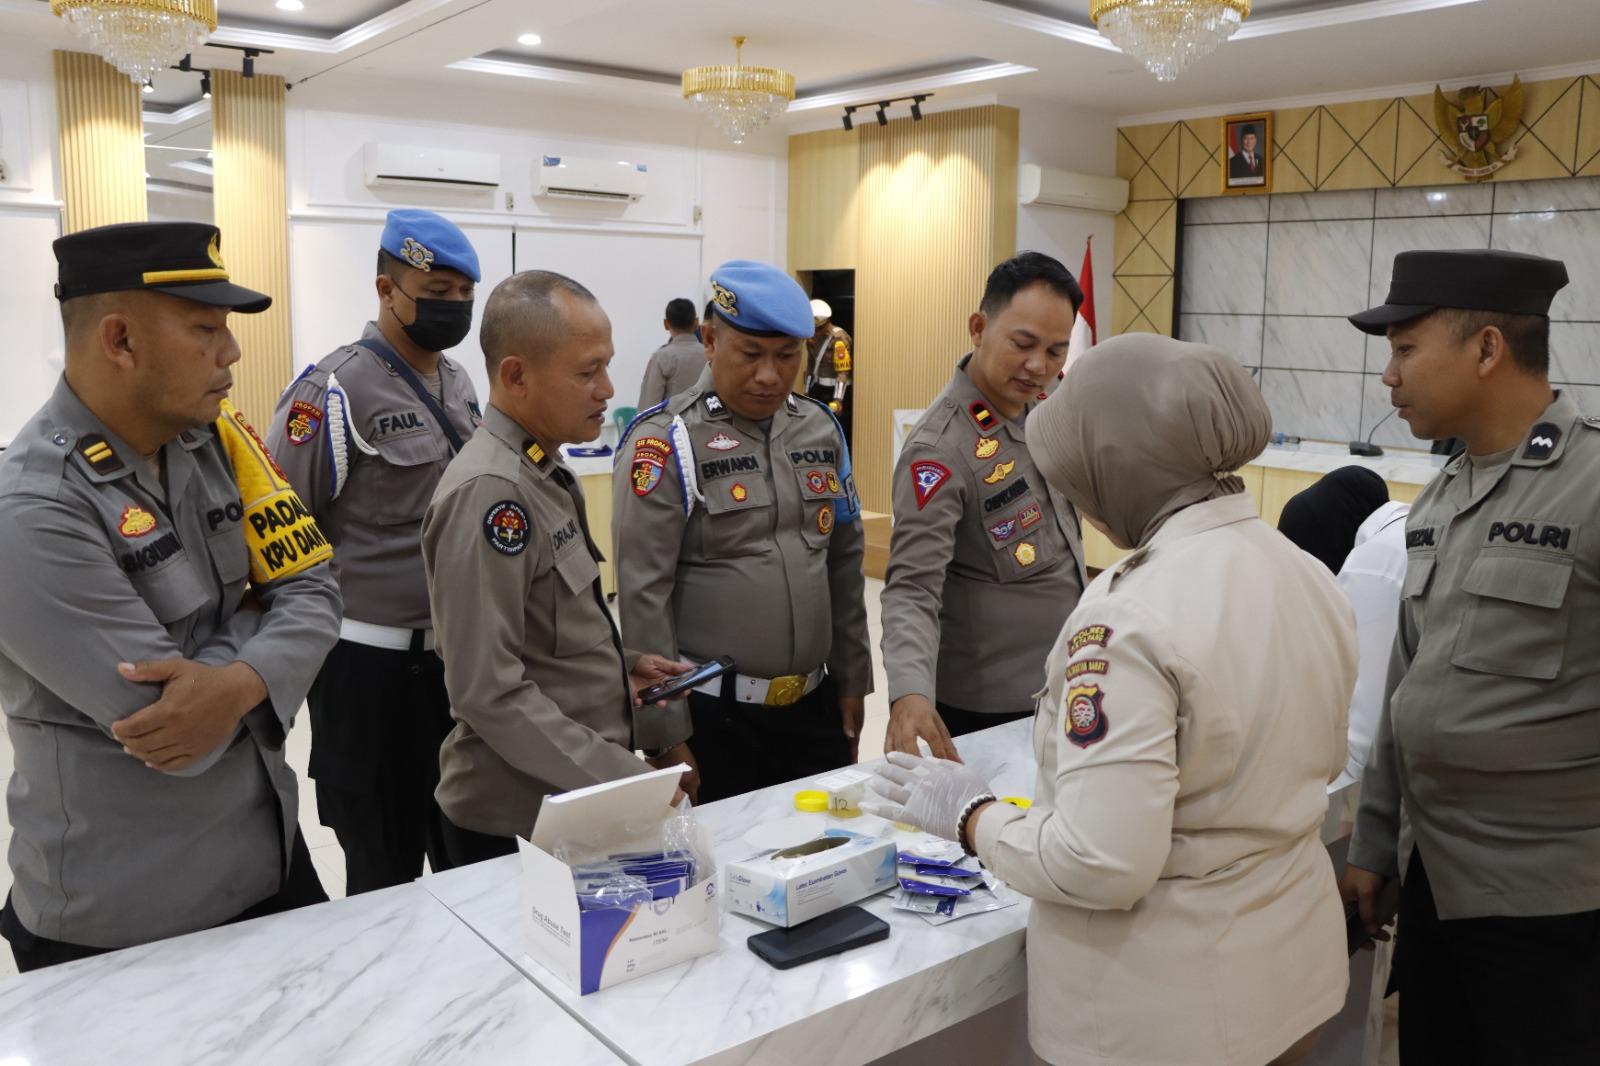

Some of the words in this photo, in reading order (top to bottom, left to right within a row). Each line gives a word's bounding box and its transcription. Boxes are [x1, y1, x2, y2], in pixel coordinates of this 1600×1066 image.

[379, 412, 424, 436] FAUL
[701, 455, 758, 479] ERWANDI
[791, 450, 834, 464] POLRI
[1488, 521, 1571, 550] POLRI
[260, 535, 298, 573] KPU
